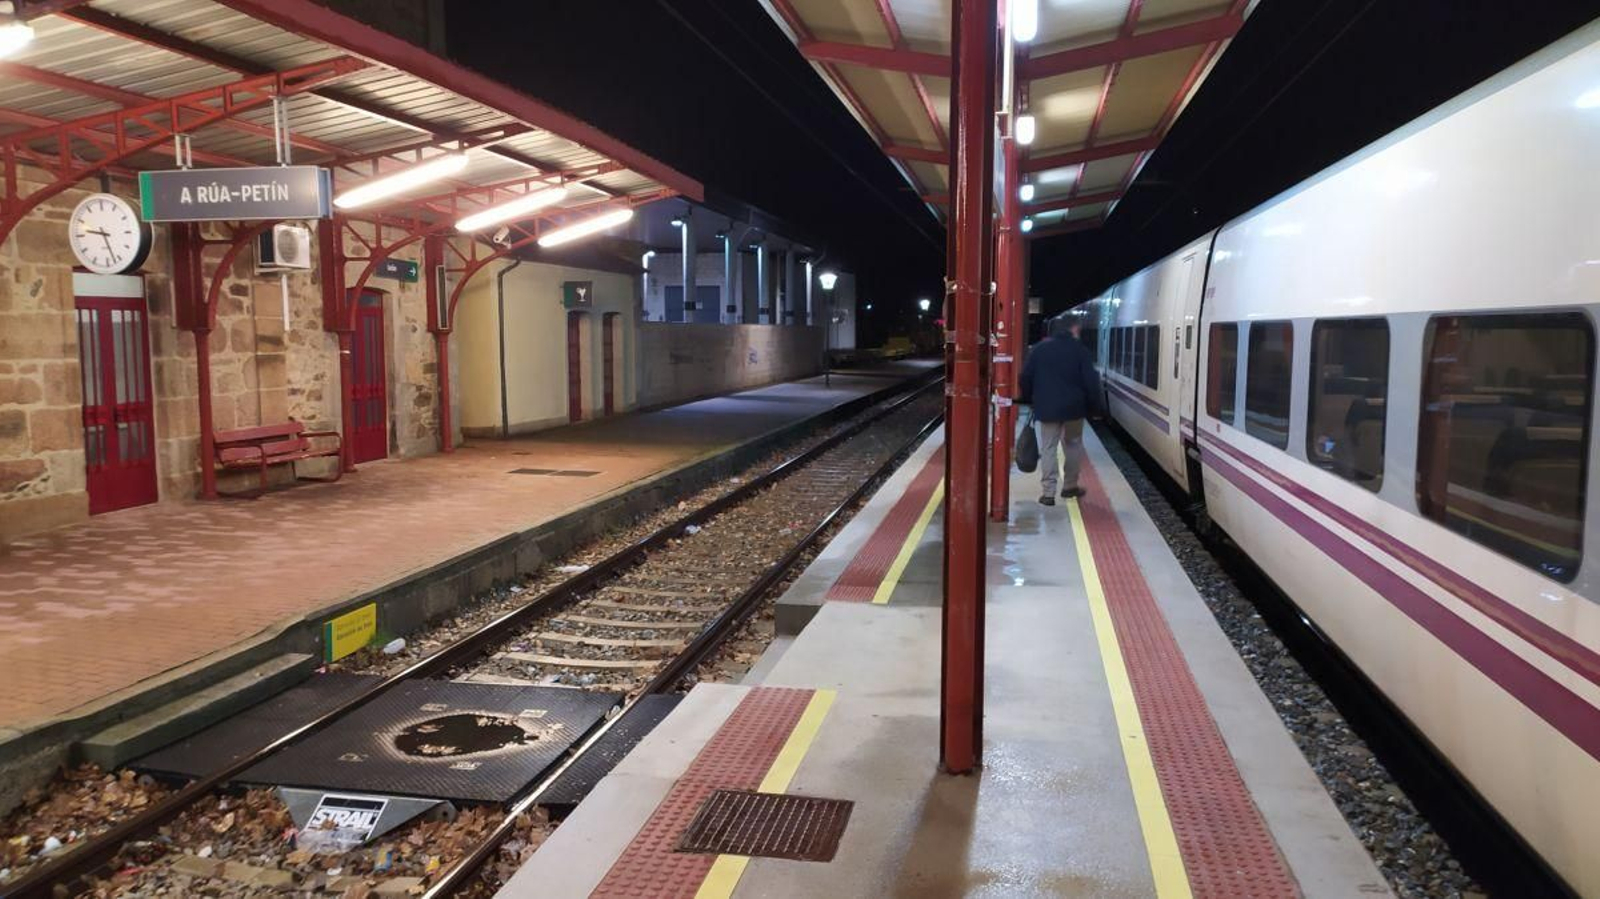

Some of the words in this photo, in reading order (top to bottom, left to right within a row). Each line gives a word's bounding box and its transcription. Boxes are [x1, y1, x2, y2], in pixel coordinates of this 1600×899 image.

[180, 186, 192, 204] A
[197, 181, 289, 203] RÚA-PETÍN
[312, 808, 373, 829] STRAIL
